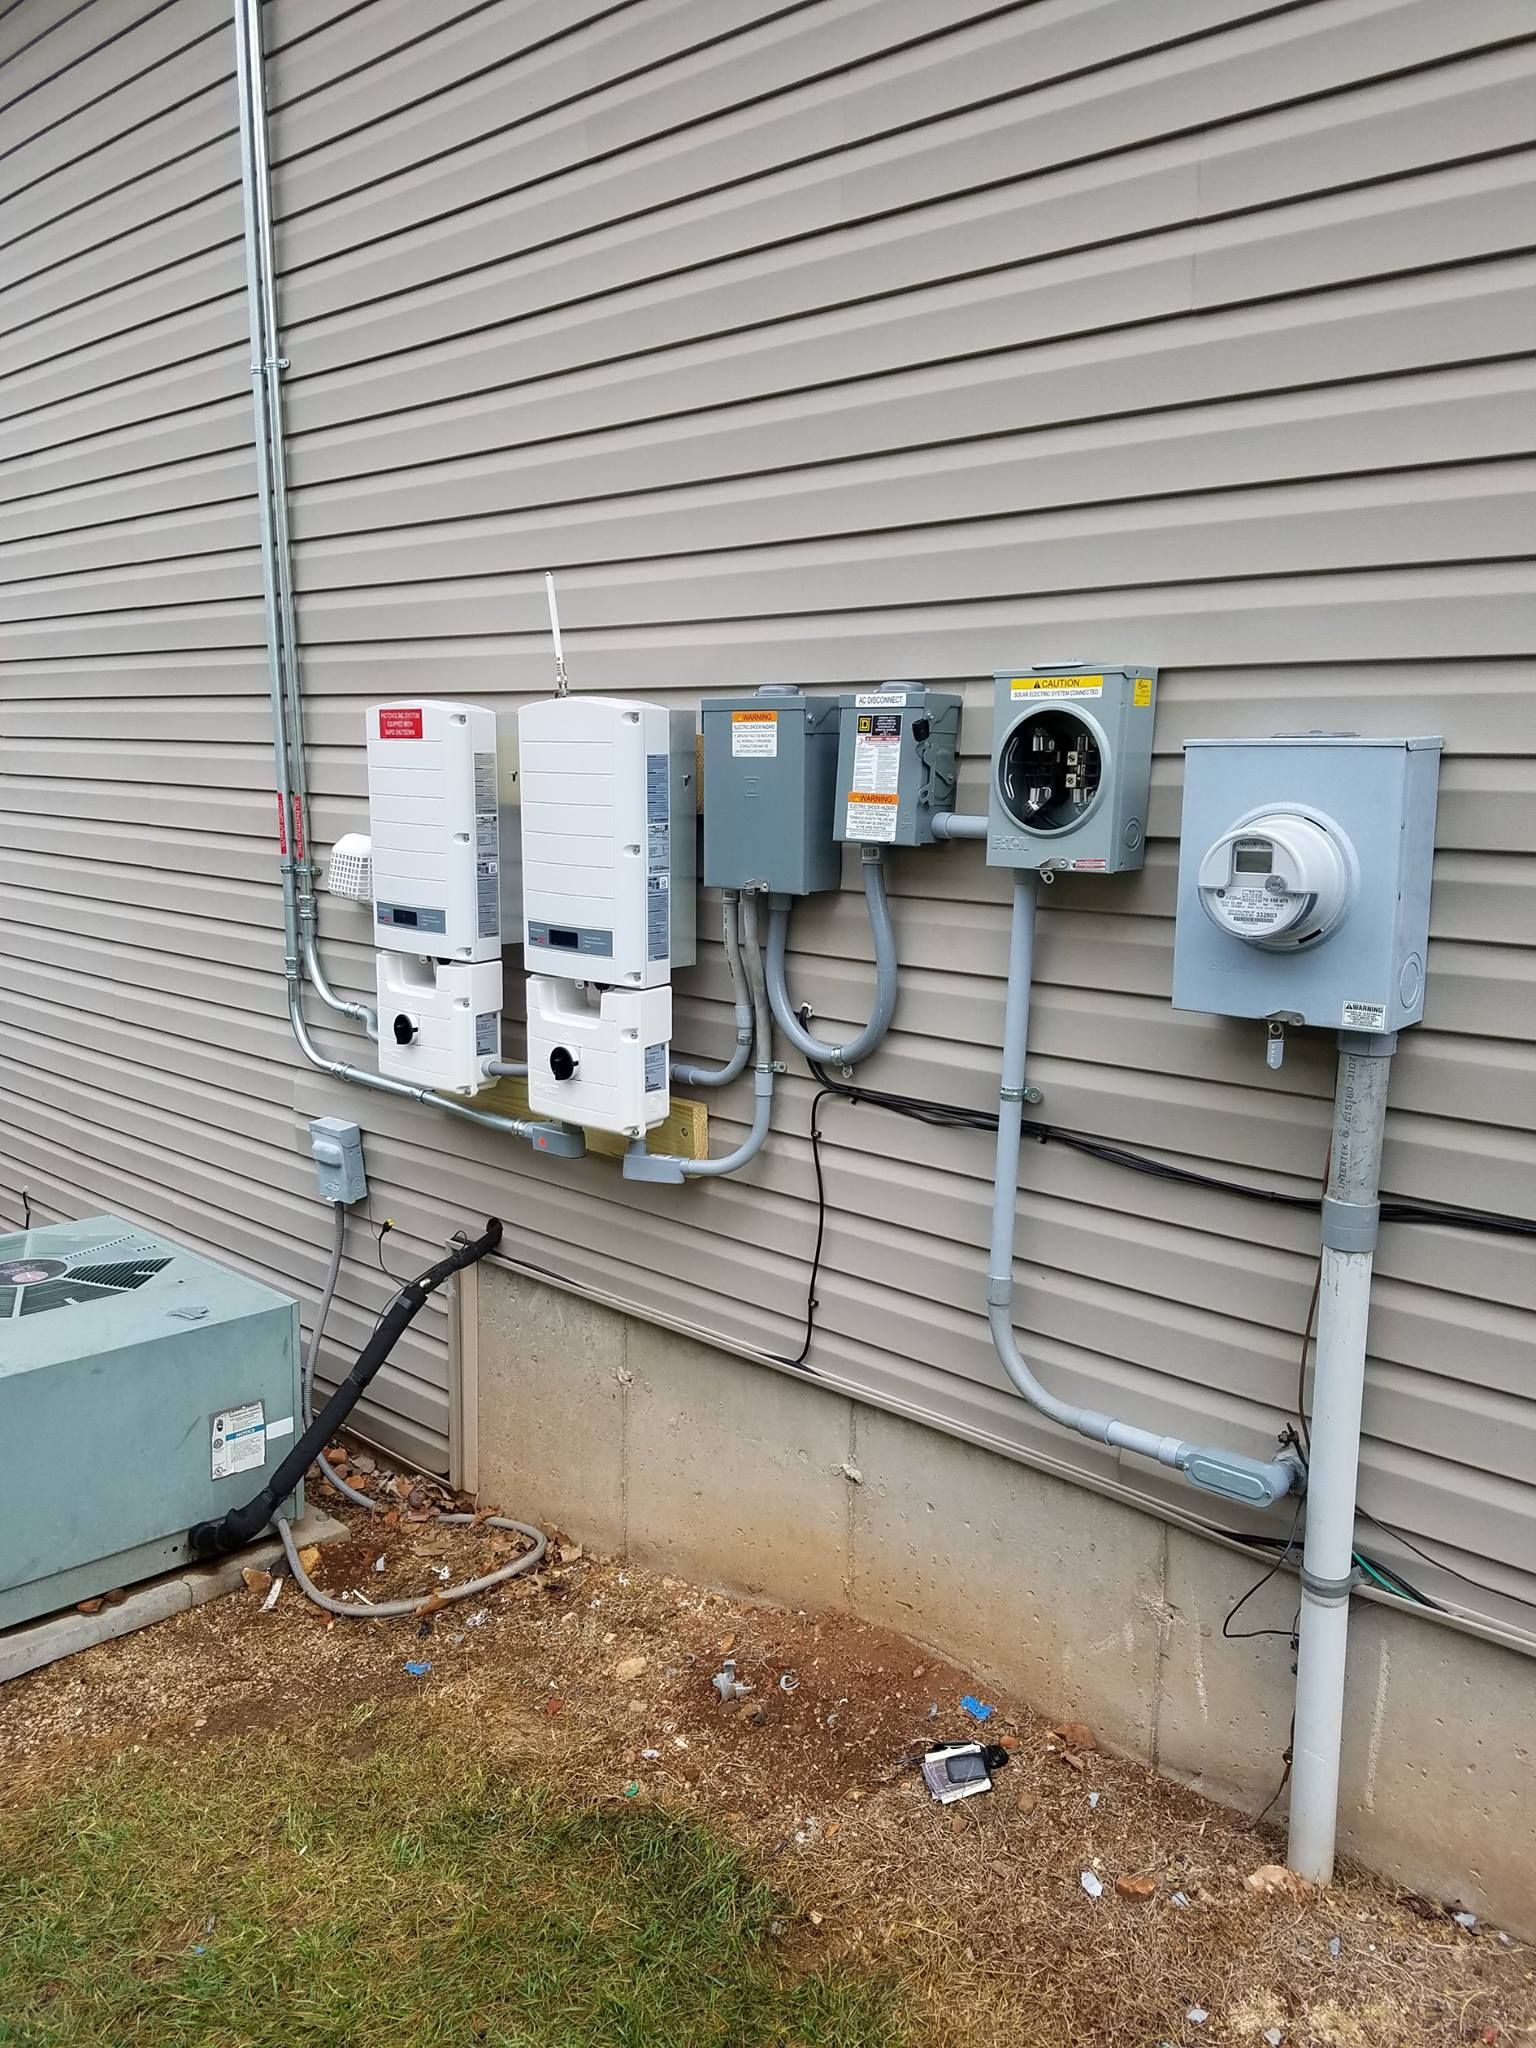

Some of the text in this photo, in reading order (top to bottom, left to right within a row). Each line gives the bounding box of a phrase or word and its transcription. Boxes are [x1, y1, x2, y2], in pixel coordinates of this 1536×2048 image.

[1042, 679, 1080, 688] CAUTION
[868, 696, 903, 704] DISCONNECT
[743, 713, 772, 721] WARNING
[860, 794, 892, 803] WARNING
[1353, 1004, 1383, 1013] WARNING
[1338, 1144, 1348, 1188] INTERTEK
